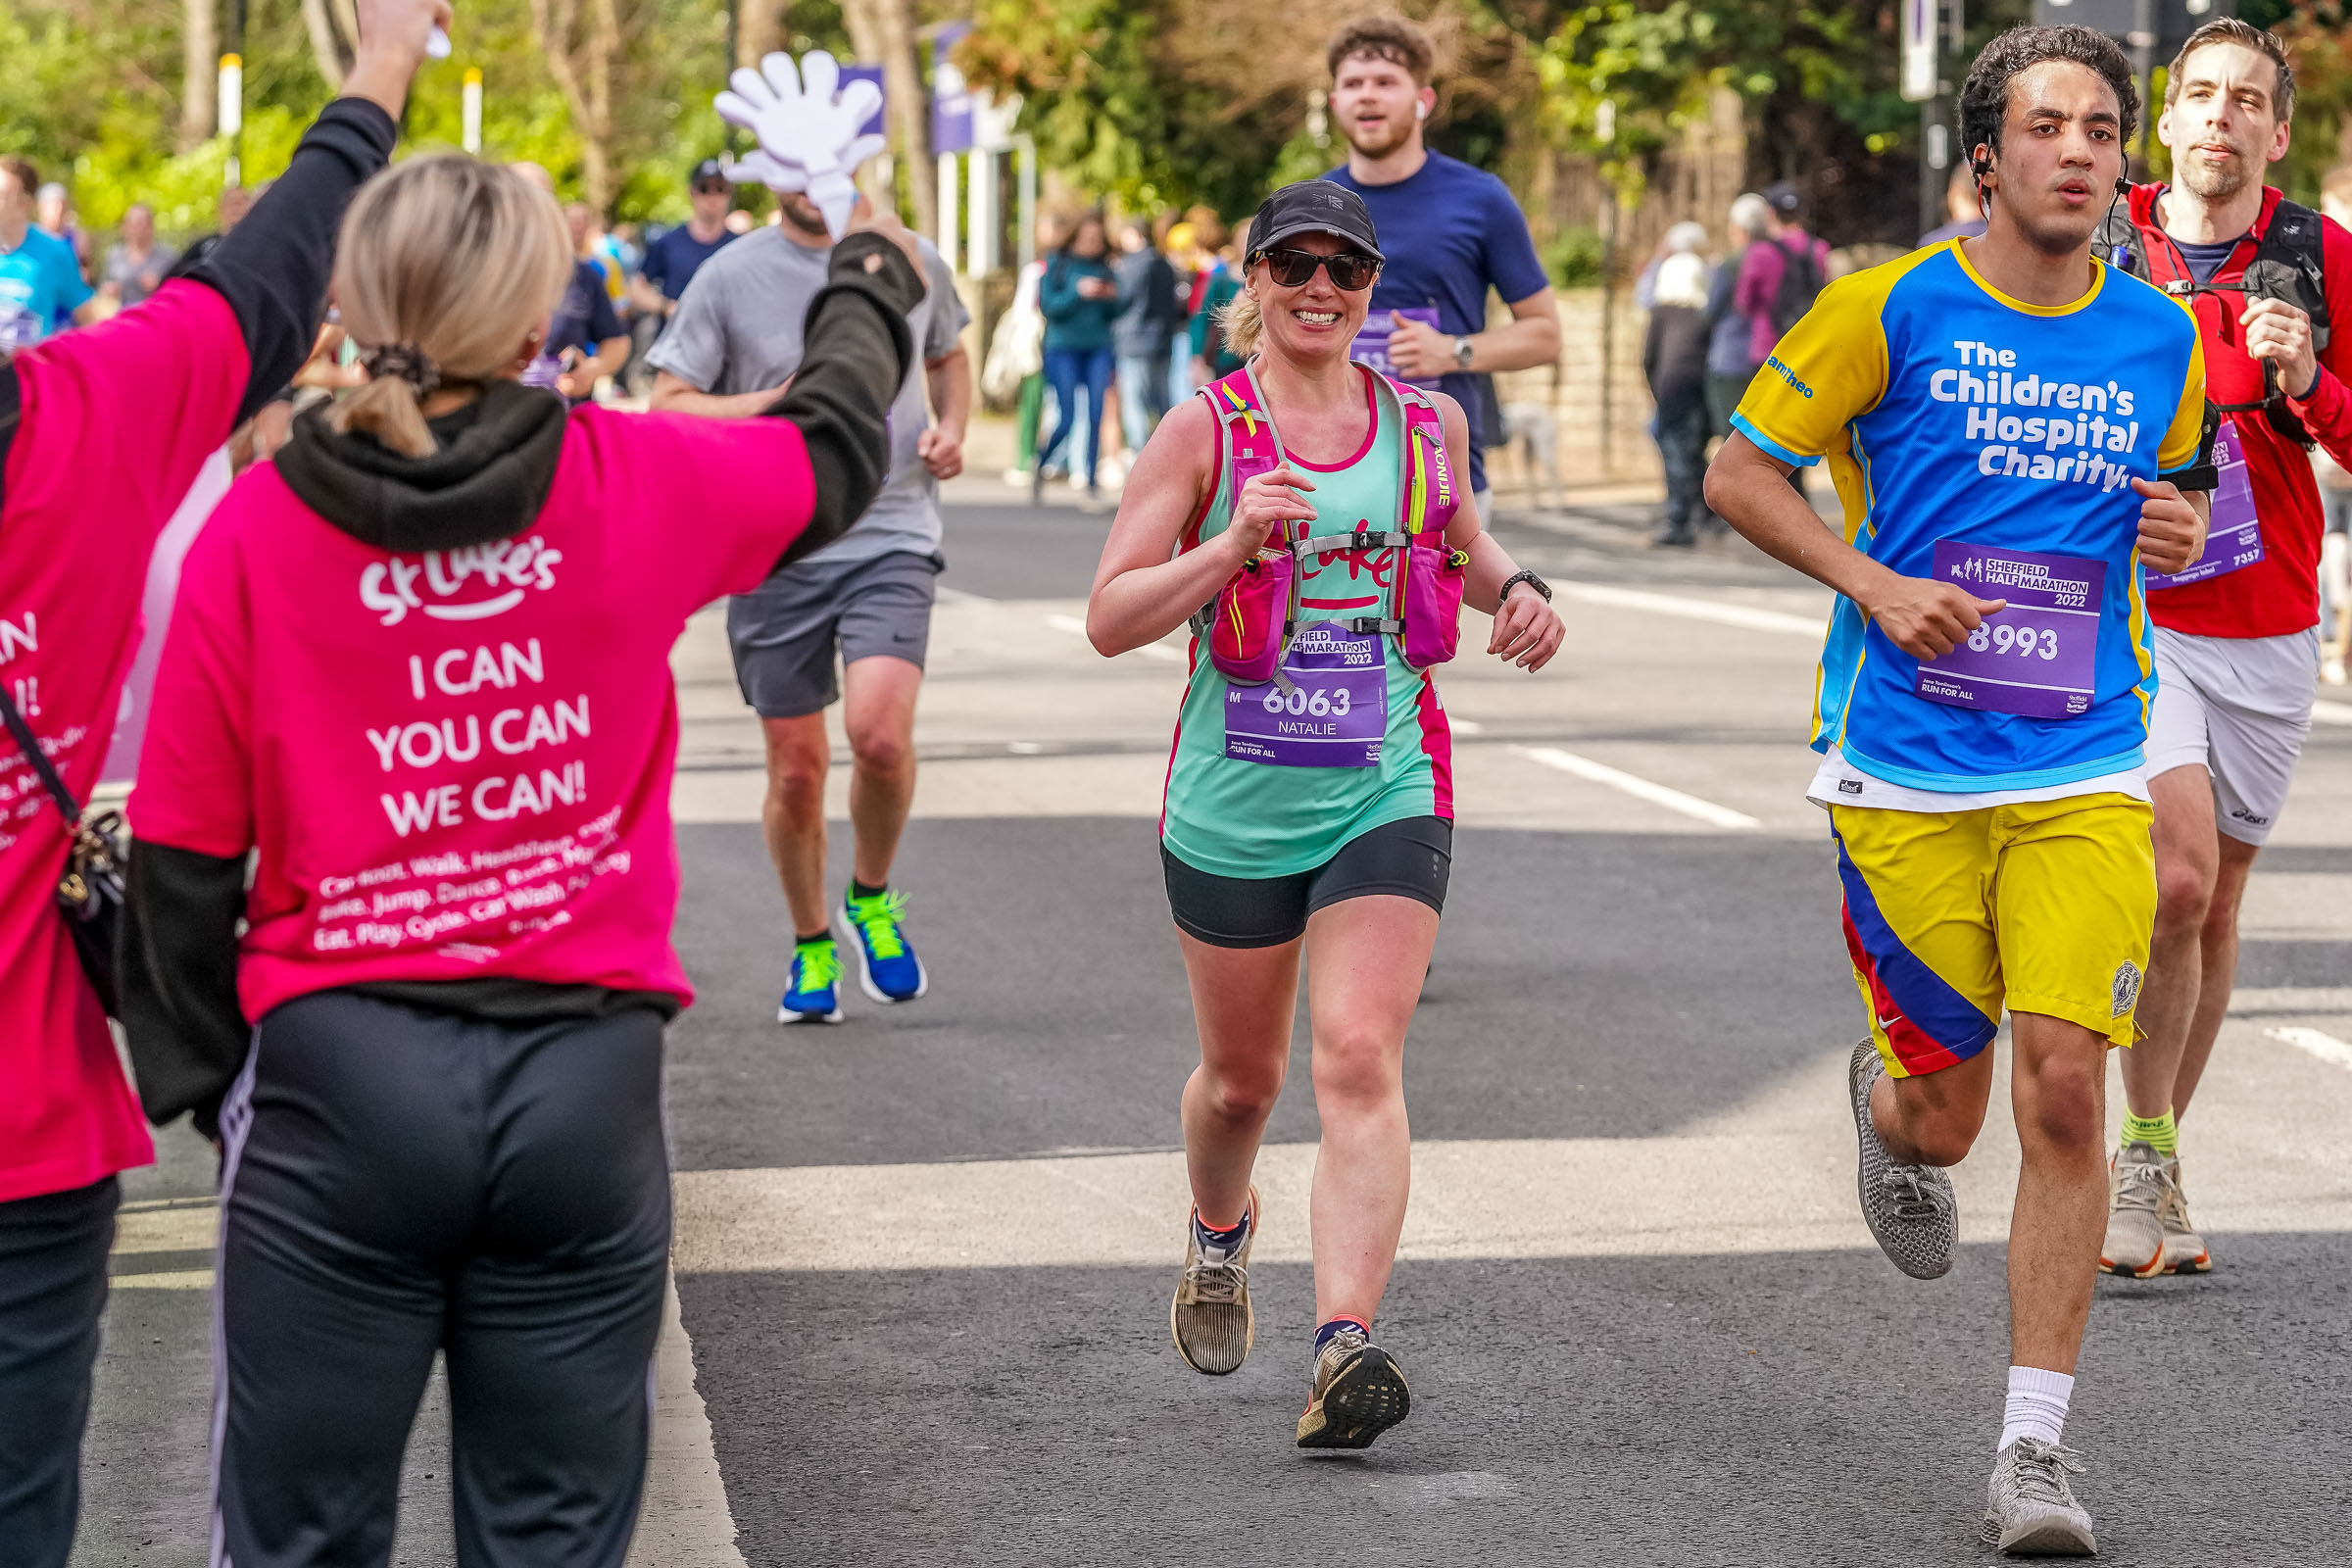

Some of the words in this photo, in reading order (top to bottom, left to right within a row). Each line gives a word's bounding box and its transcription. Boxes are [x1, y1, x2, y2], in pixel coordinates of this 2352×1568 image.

[1954, 340, 2017, 368] The
[1930, 368, 2135, 417] Children's
[1965, 407, 2139, 454] Hospital
[1435, 446, 1450, 507] AONIJIE
[1978, 444, 2127, 494] Charity
[1987, 560, 2047, 577] SHEFFIELD
[2233, 548, 2260, 567] 7357
[359, 556, 422, 626] St
[423, 535, 563, 597] Luke's
[1985, 571, 2019, 586] HALF
[2020, 576, 2088, 594] MARATHON
[2054, 593, 2086, 608] 2022
[1304, 641, 1370, 654] MARATHON
[1968, 621, 2058, 661] 8993
[409, 654, 426, 701] I
[433, 637, 545, 697] CAN
[1344, 653, 1372, 665] 2022
[1229, 691, 1242, 704] M
[1262, 687, 1351, 717] 6063
[1922, 683, 1940, 694] RUN
[1940, 687, 1958, 698] FOR
[1958, 690, 1974, 701] ALL
[366, 714, 481, 772] YOU
[489, 693, 591, 755] CAN
[1278, 720, 1337, 735] NATALIE
[1247, 747, 1262, 756] FOR
[1262, 749, 1276, 758] ALL
[380, 783, 464, 836] WE
[471, 759, 587, 821] CAN!
